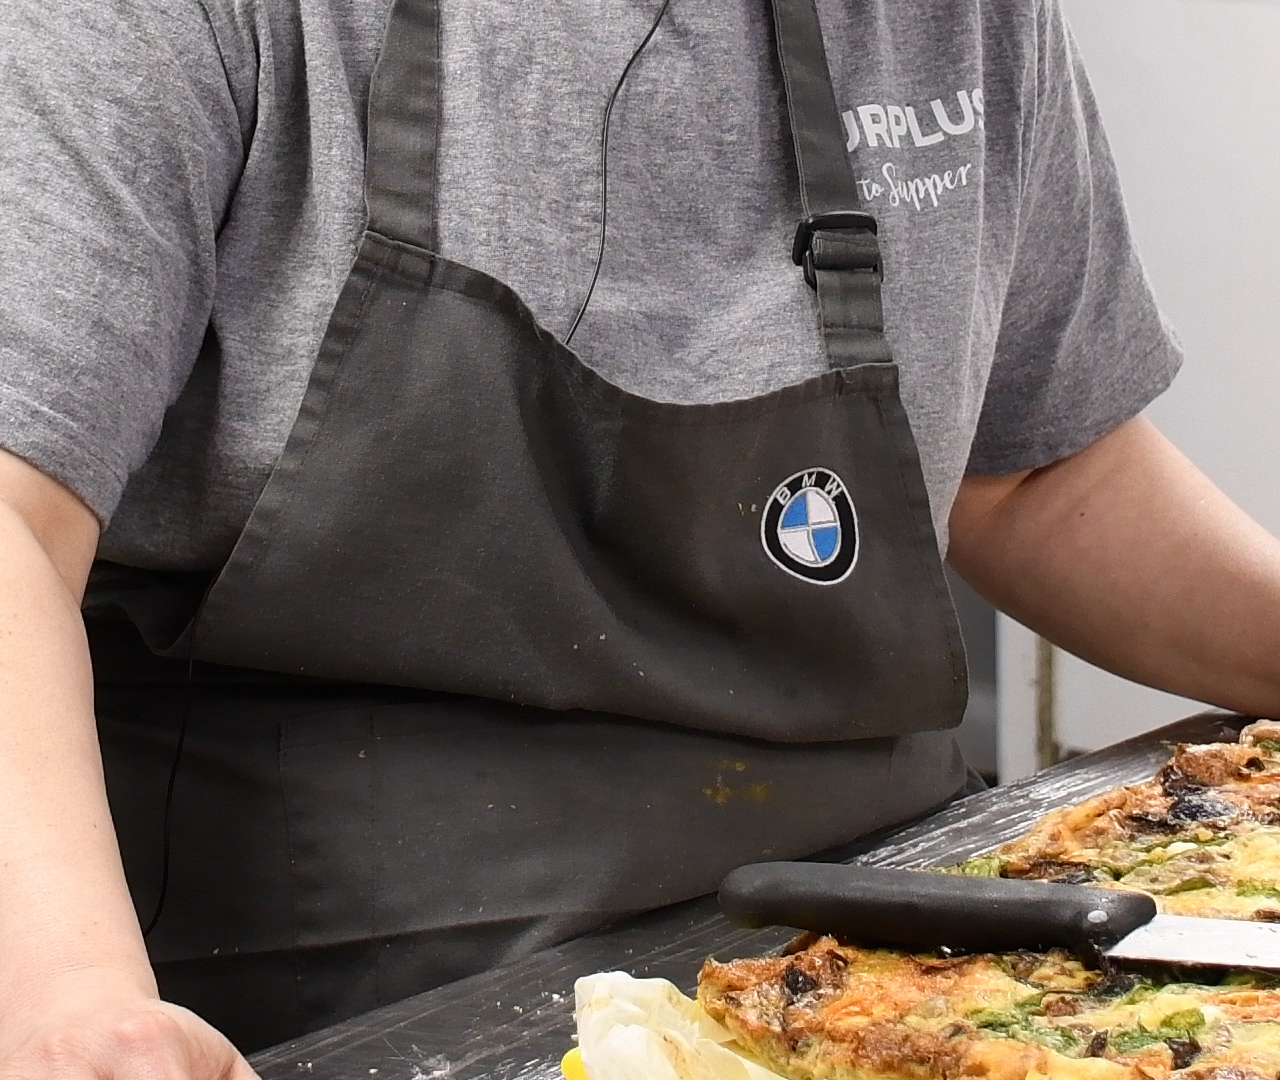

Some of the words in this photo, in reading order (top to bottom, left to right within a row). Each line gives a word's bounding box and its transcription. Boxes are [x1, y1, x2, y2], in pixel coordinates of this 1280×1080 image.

[856, 178, 884, 201] to
[881, 162, 972, 211] Supper
[776, 471, 844, 506] BMW
